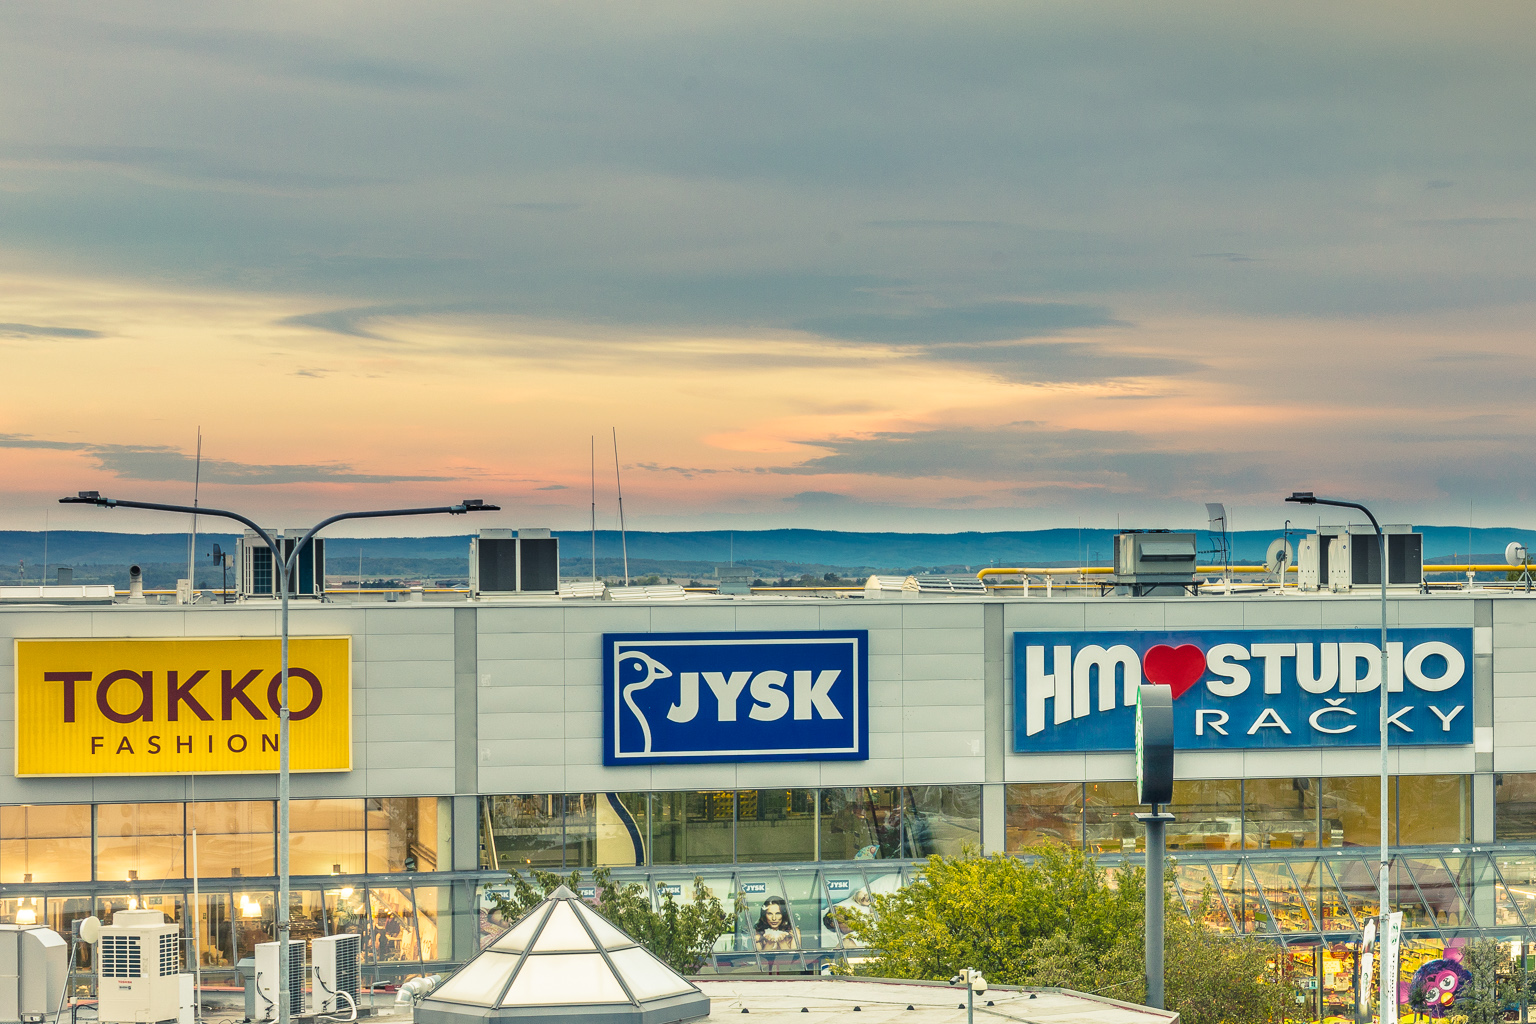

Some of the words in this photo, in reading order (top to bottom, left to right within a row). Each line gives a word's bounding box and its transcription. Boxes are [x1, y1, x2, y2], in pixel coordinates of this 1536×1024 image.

[667, 669, 843, 723] JYSK
[1026, 644, 1141, 737] HM
[1206, 641, 1465, 697] STUDIO
[1195, 698, 1464, 736] RAČKY
[91, 734, 278, 754] FASHION
[745, 884, 765, 892] JYSK
[829, 881, 849, 889] JYSK
